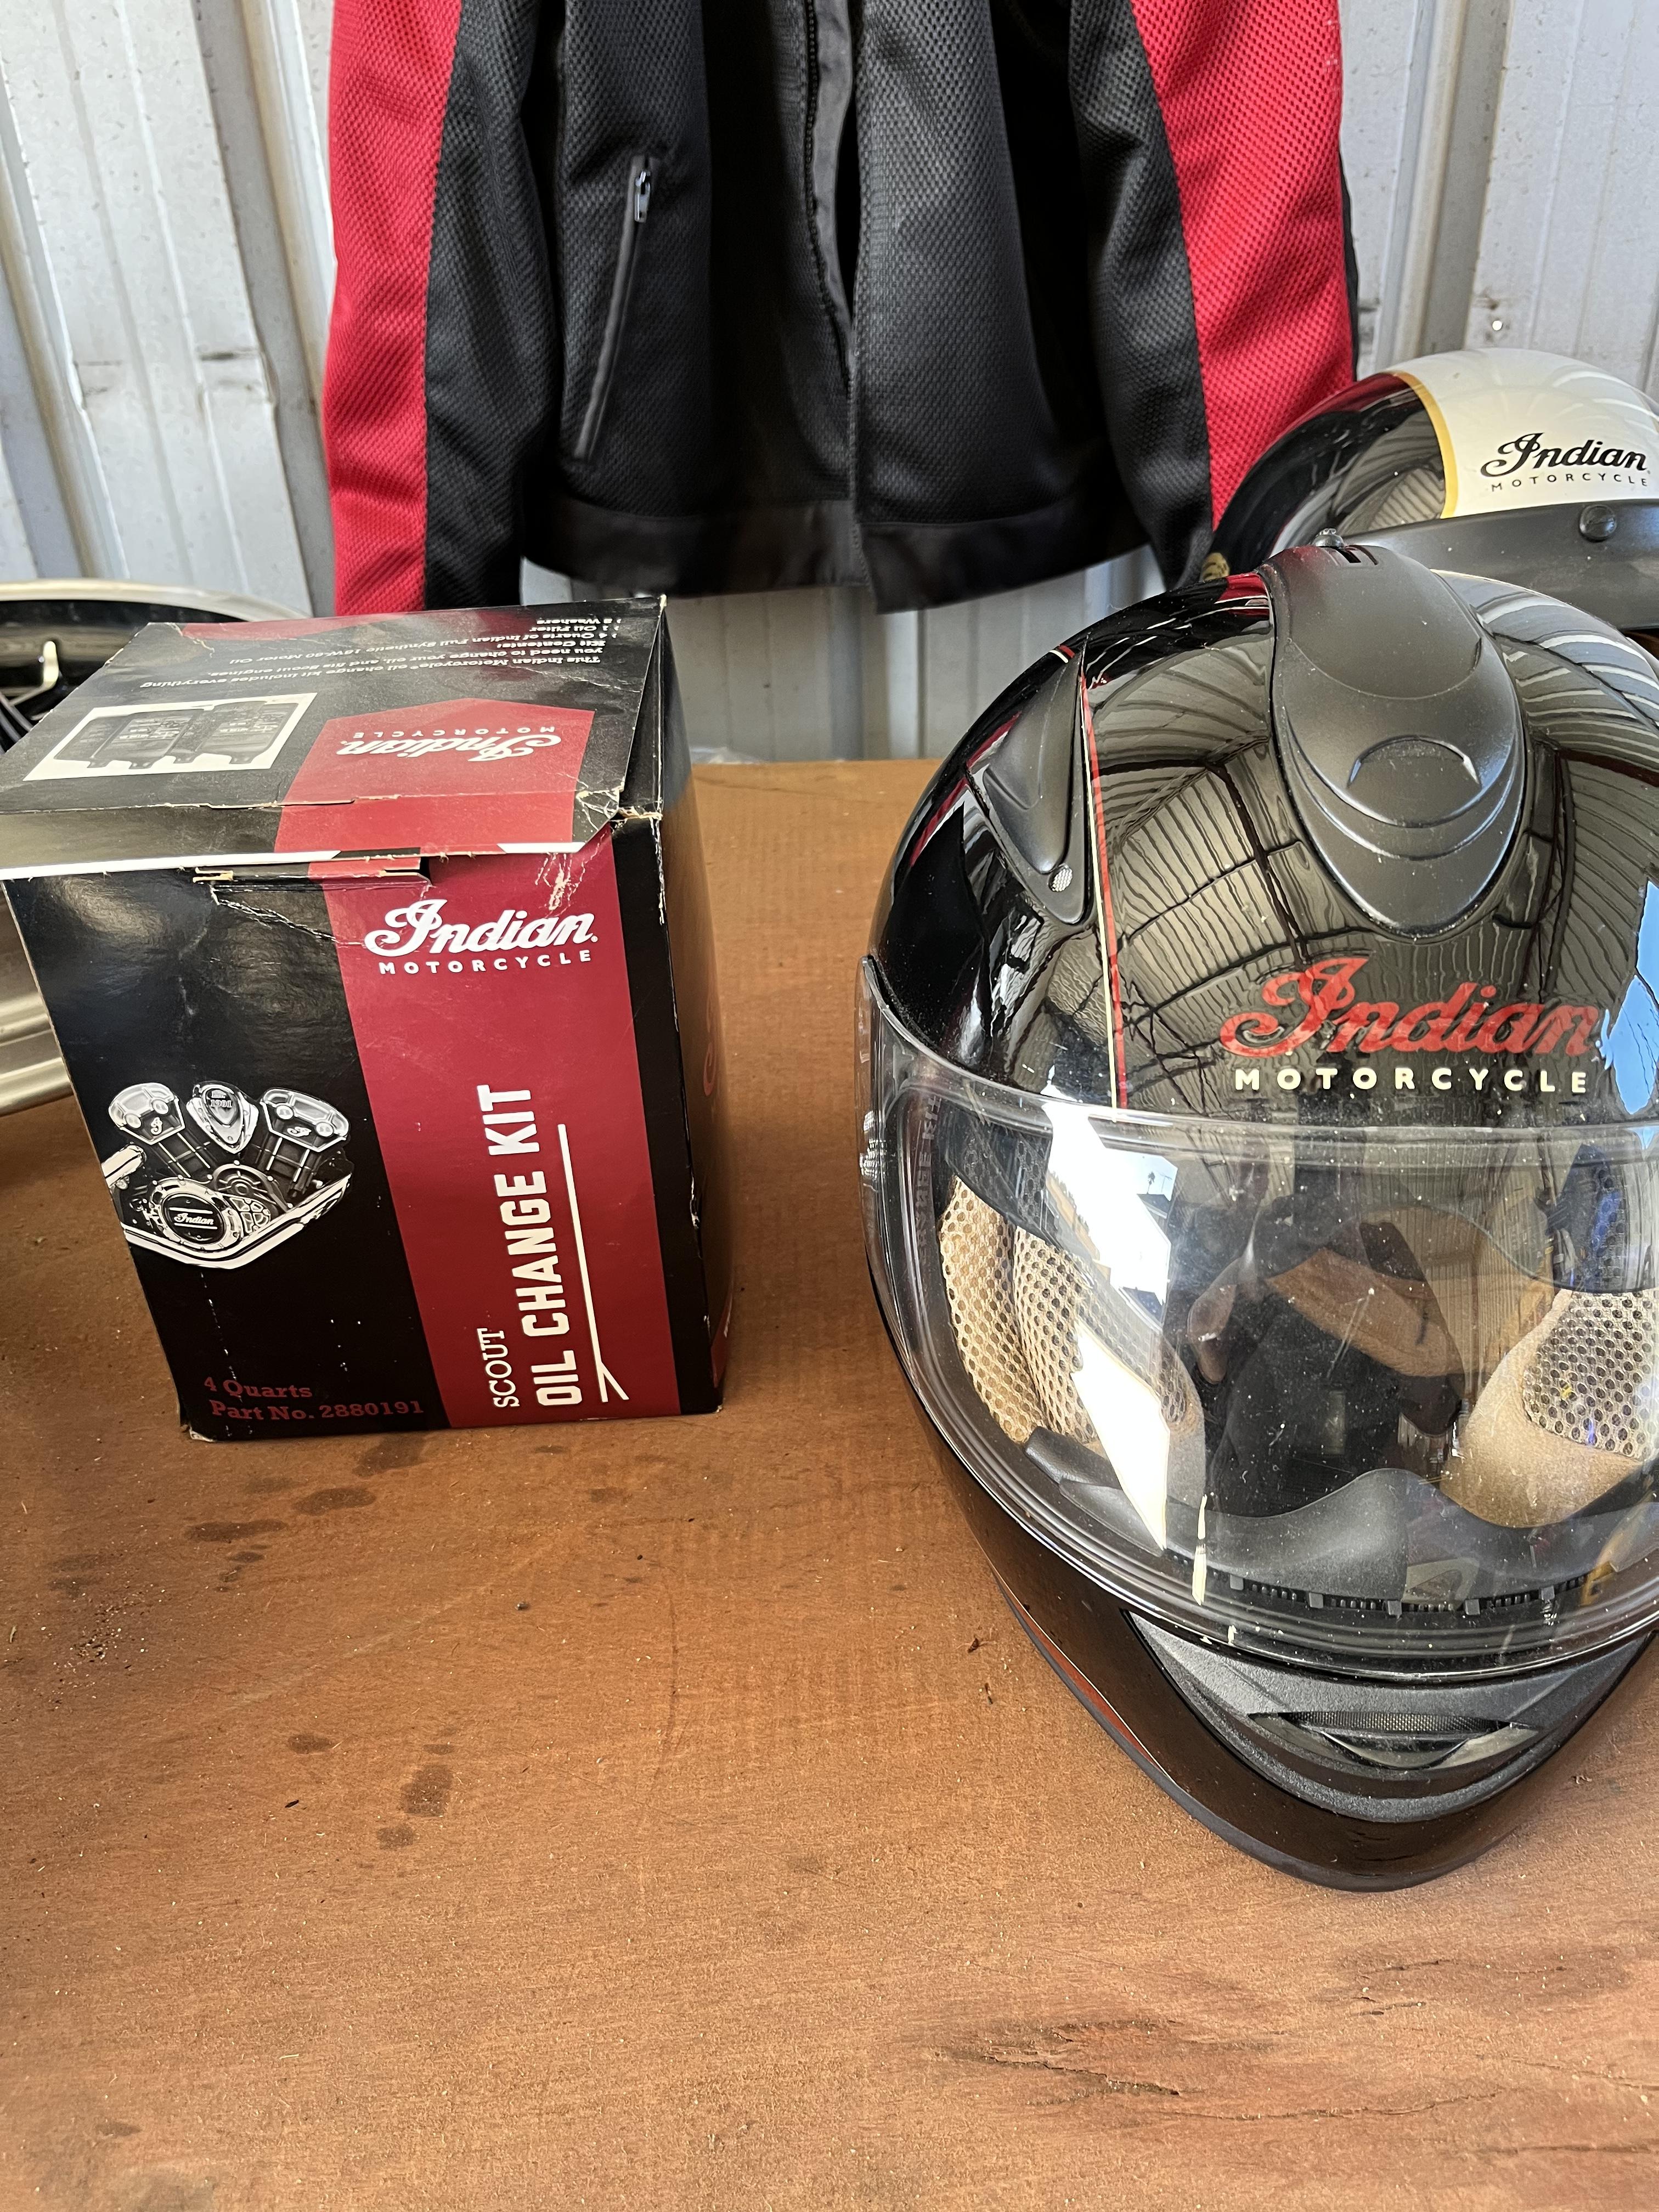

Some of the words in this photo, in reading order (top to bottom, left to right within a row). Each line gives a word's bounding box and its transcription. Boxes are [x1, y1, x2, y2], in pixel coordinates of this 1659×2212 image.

[1480, 432, 1647, 477] Indian
[1491, 473, 1647, 492] MOTORCYCLE
[366, 642, 436, 652] Synthetic
[140, 679, 227, 688] everything
[231, 673, 298, 681] includes
[353, 726, 555, 738] MOTORCYCLE
[336, 734, 562, 761] Indian
[364, 899, 595, 956] Indian
[379, 950, 591, 974] MOTORCYCLE
[1219, 956, 1599, 1058] Indian
[1234, 1068, 1587, 1094] MOTORCYCLE
[477, 1084, 540, 1156] KIT
[174, 1213, 214, 1224] Indian
[494, 1171, 569, 1337] CHANGE
[477, 1327, 520, 1408] SCOUT
[531, 1350, 583, 1406] OIL
[204, 1376, 217, 1392] 4
[223, 1380, 313, 1398] Quarts
[208, 1400, 264, 1420] Part
[268, 1406, 315, 1420] No.
[319, 1401, 424, 1419] 2880191
